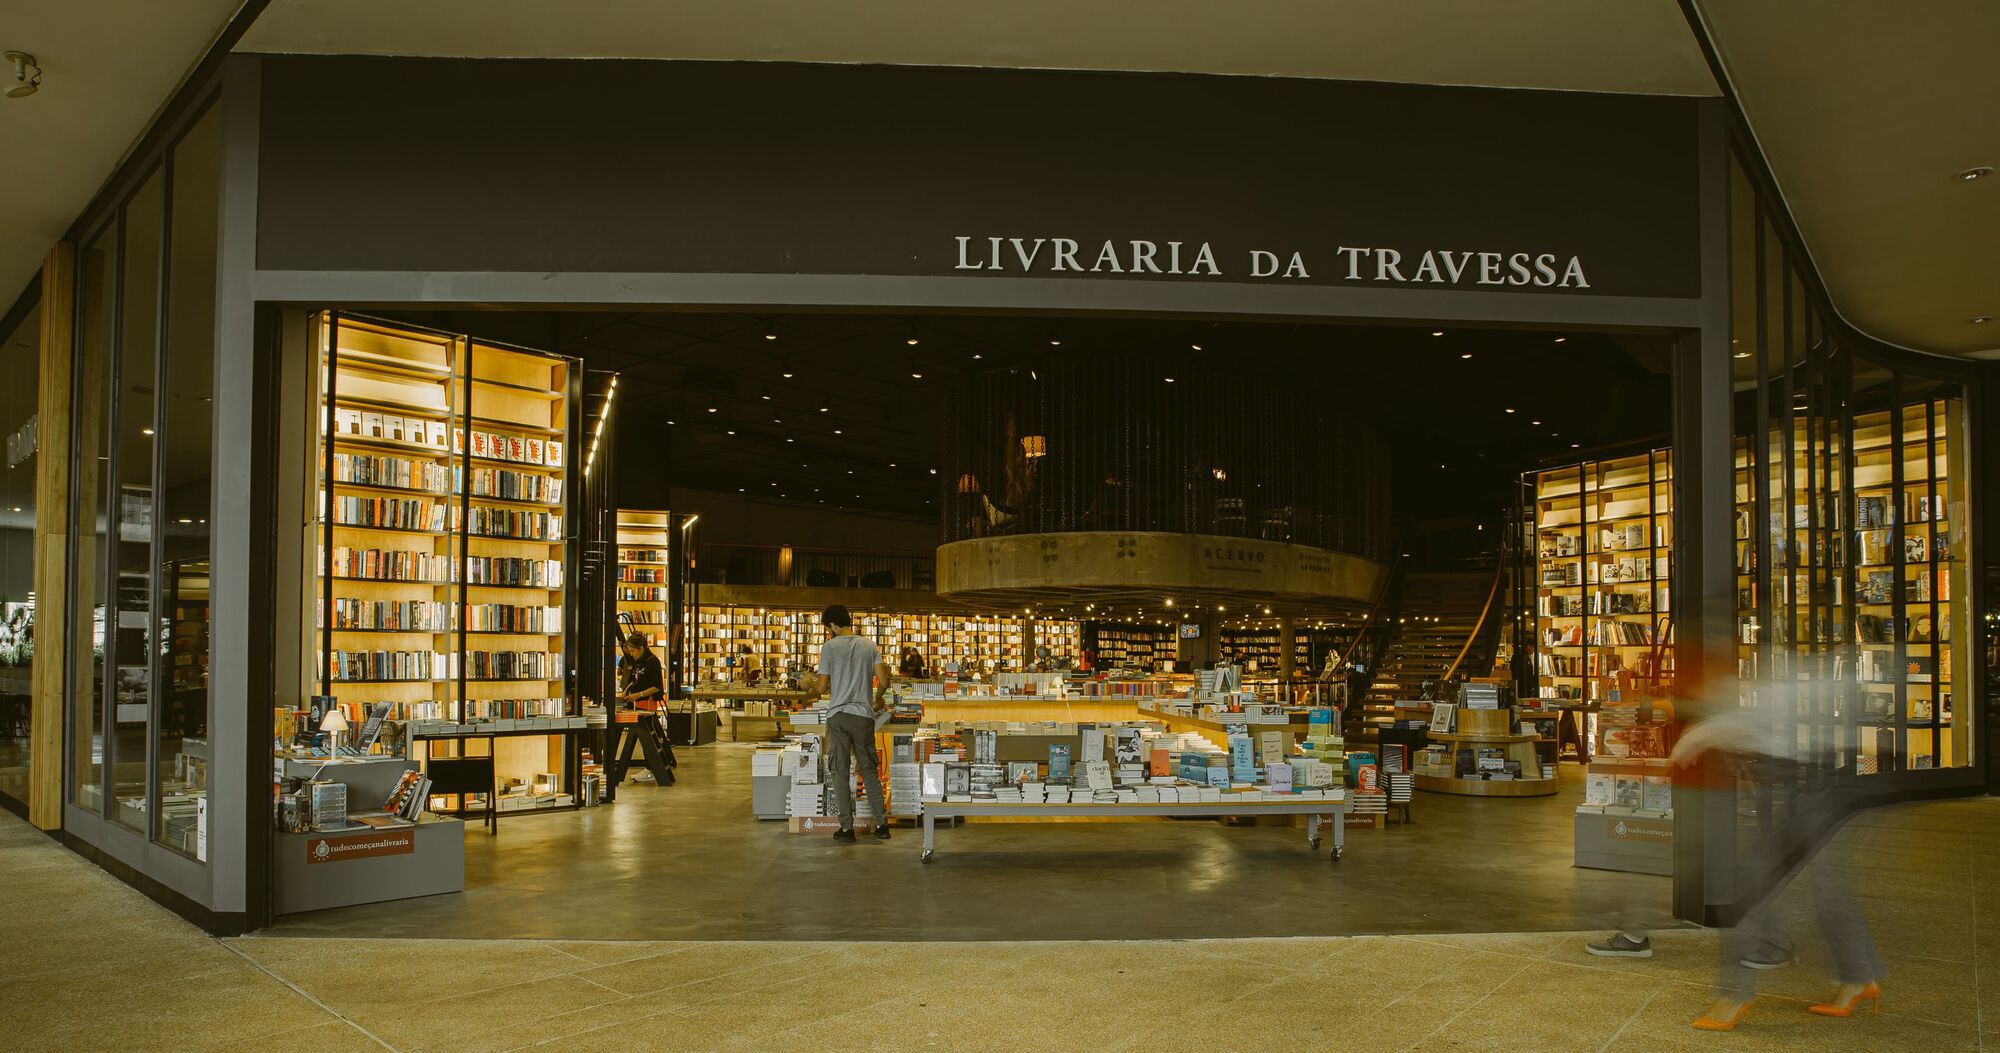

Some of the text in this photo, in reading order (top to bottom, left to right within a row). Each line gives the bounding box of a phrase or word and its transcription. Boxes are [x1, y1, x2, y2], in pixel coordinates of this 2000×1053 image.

[954, 236, 1592, 289] LIVRARIA DA TRAVESSA
[1859, 498, 1868, 527] KIMONO
[1204, 547, 1265, 564] ACERVO
[1366, 769, 1376, 789] DURAS
